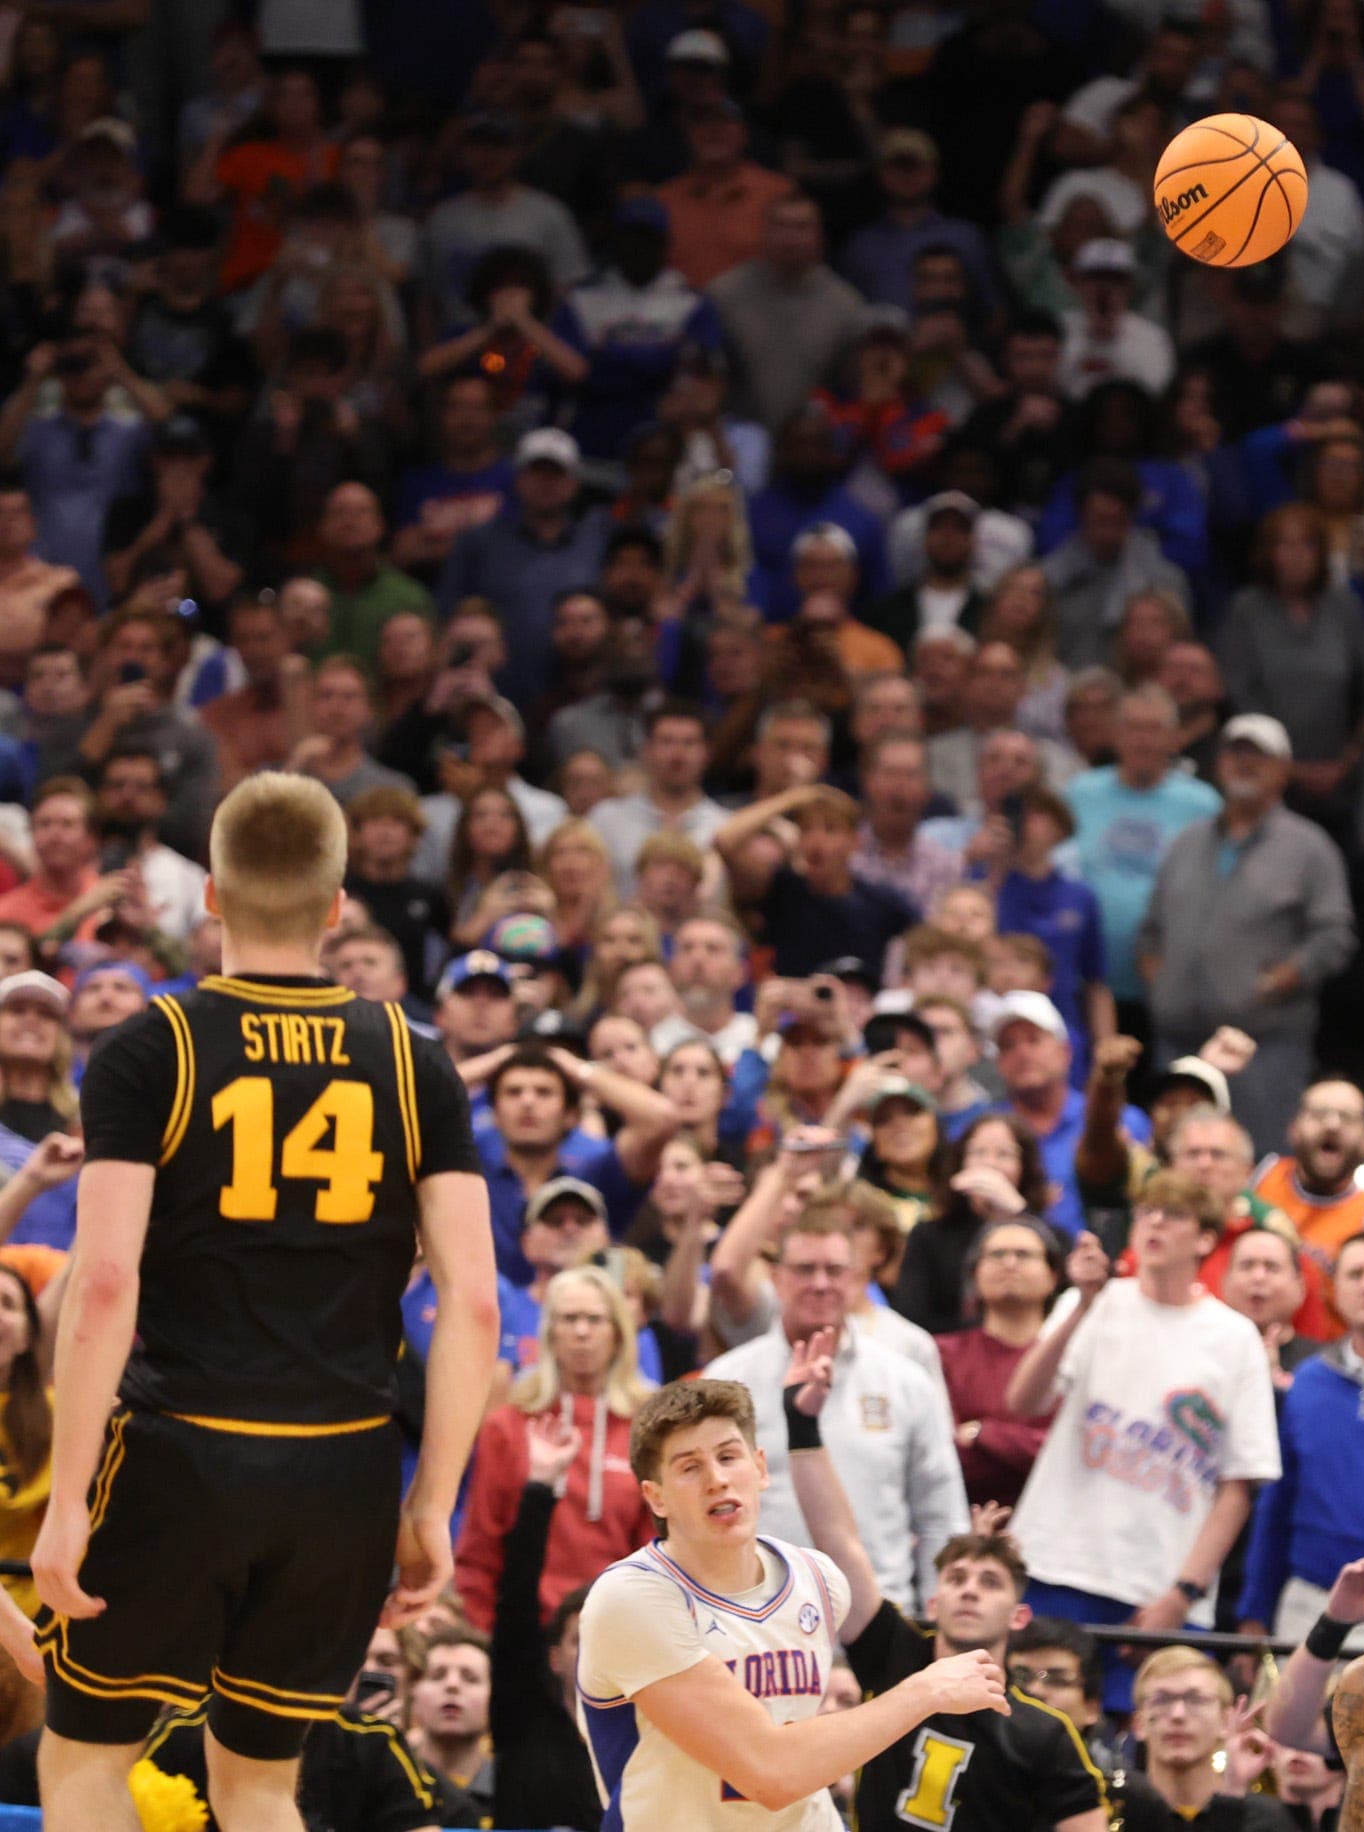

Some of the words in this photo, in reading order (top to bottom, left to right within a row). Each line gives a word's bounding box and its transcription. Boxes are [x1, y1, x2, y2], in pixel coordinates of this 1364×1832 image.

[240, 1010, 351, 1065] STIRTZ
[211, 1075, 384, 1224] 14
[725, 1648, 822, 1699] ORIDA
